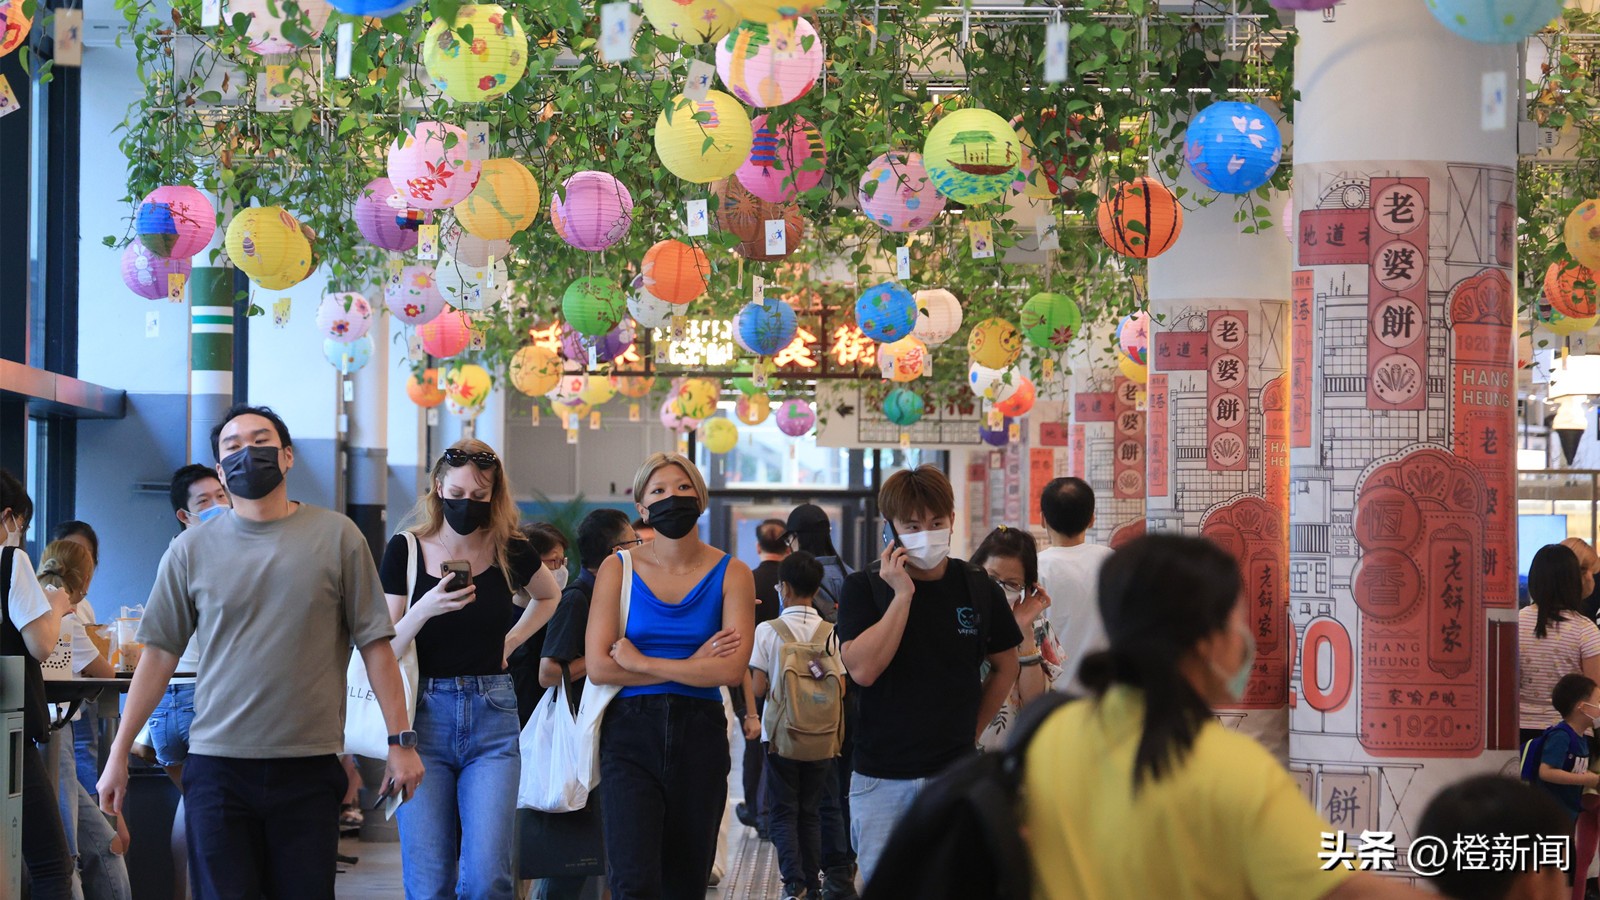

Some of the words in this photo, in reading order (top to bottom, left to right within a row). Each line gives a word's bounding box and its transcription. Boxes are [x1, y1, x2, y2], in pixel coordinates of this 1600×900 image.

[1381, 191, 1416, 338] 老婆餅
[1217, 320, 1240, 422] 老婆餅
[1462, 368, 1510, 388] HANG
[1462, 389, 1510, 407] HEUNG
[1121, 384, 1139, 461] 老婆餅
[1441, 546, 1465, 653] 老餅家
[1368, 642, 1421, 653] HANG
[1368, 655, 1421, 668] HEUNG
[1393, 714, 1455, 738] 1920
[1325, 786, 1361, 829] 餅
